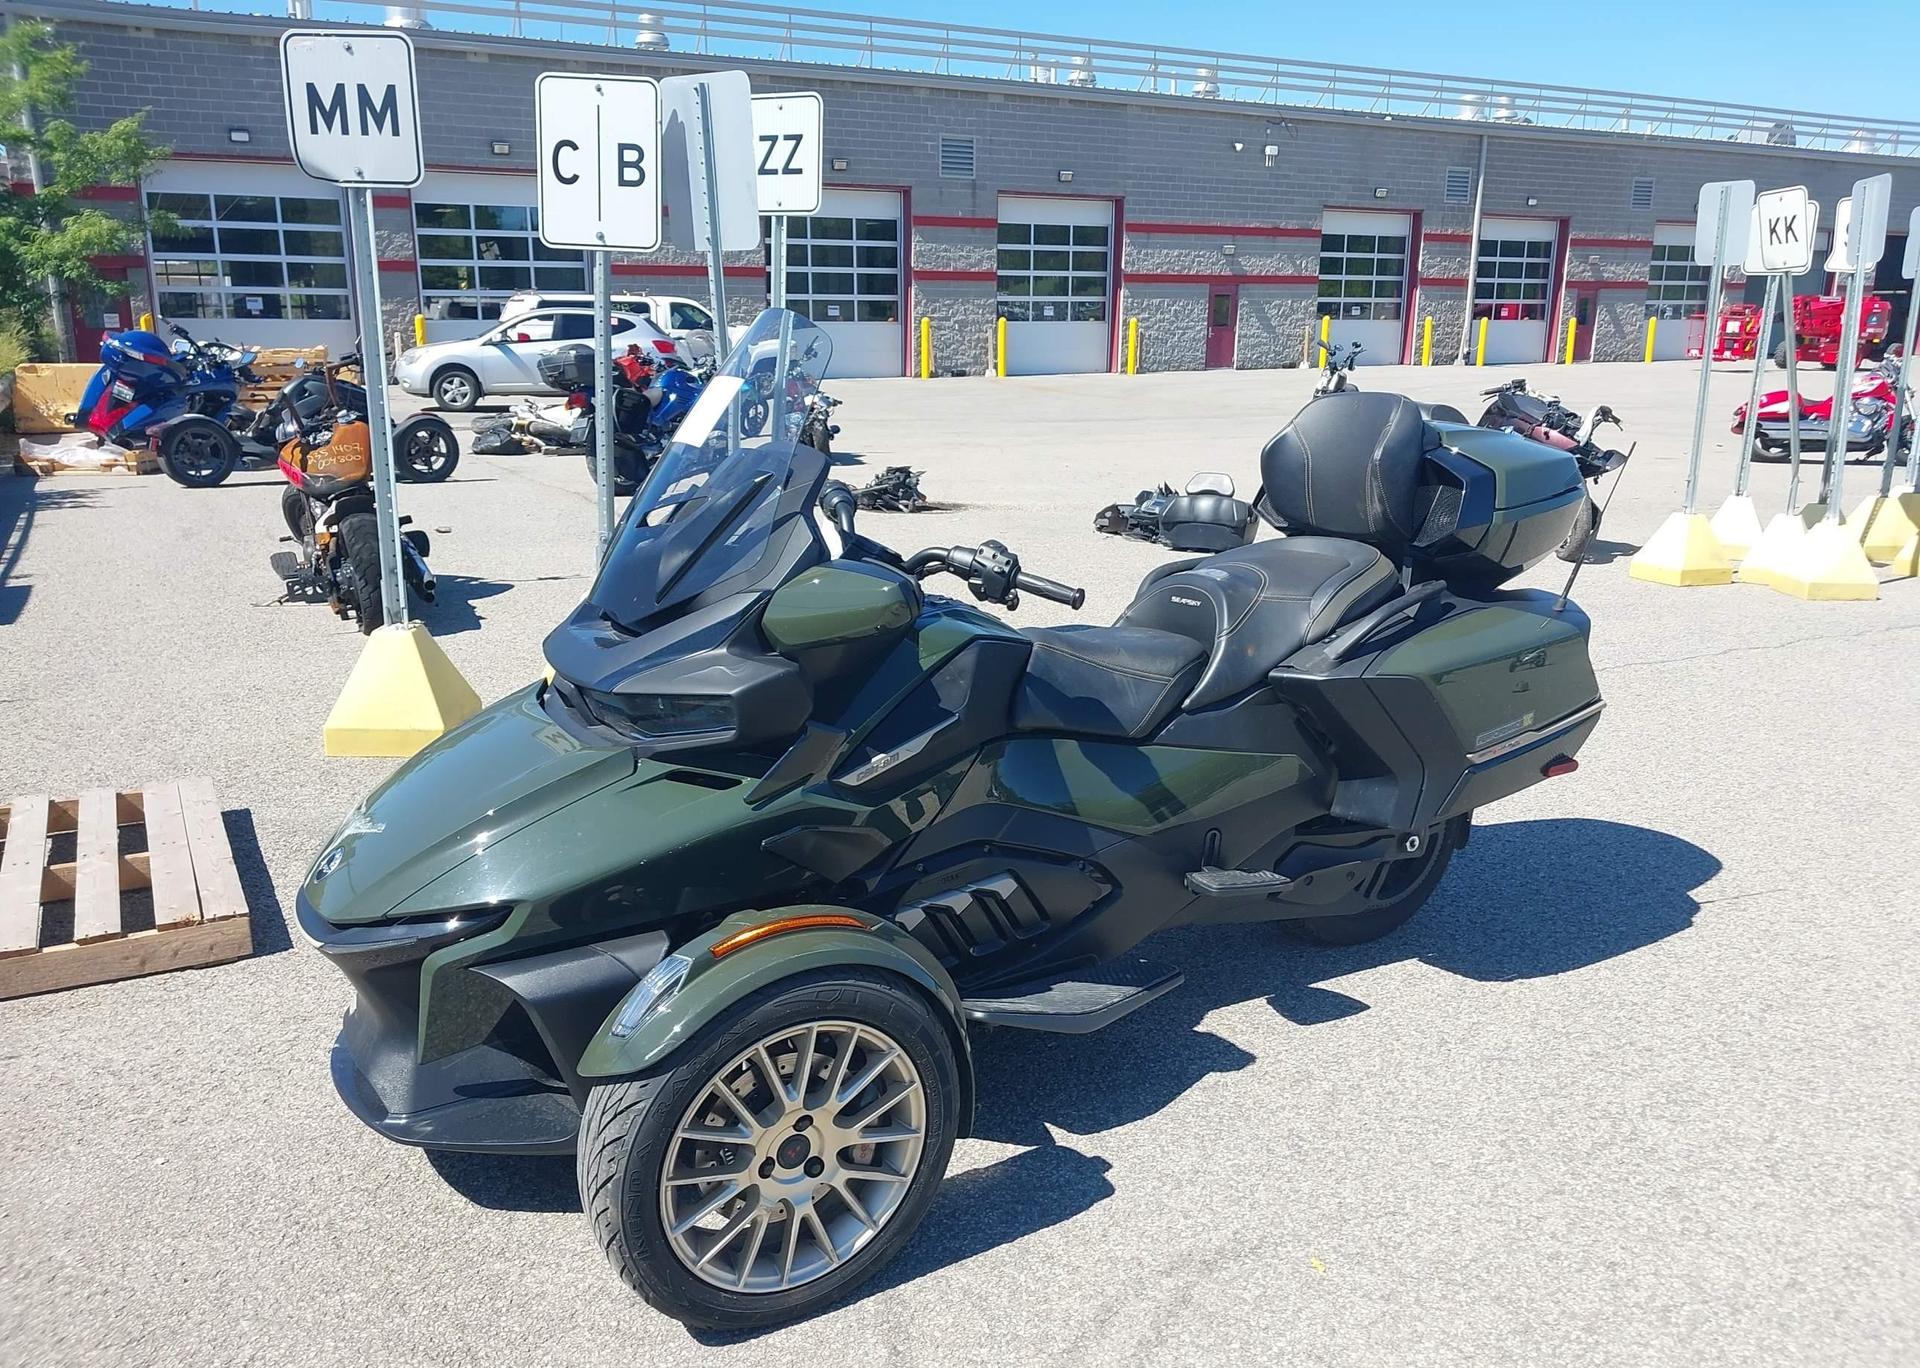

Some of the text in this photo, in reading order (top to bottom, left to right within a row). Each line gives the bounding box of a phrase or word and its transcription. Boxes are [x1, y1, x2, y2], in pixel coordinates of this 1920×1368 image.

[306, 82, 400, 137] MM
[552, 139, 646, 188] C B
[757, 134, 804, 176] ZZ
[1768, 214, 1798, 246] KK
[627, 1139, 653, 1261] KENDA
